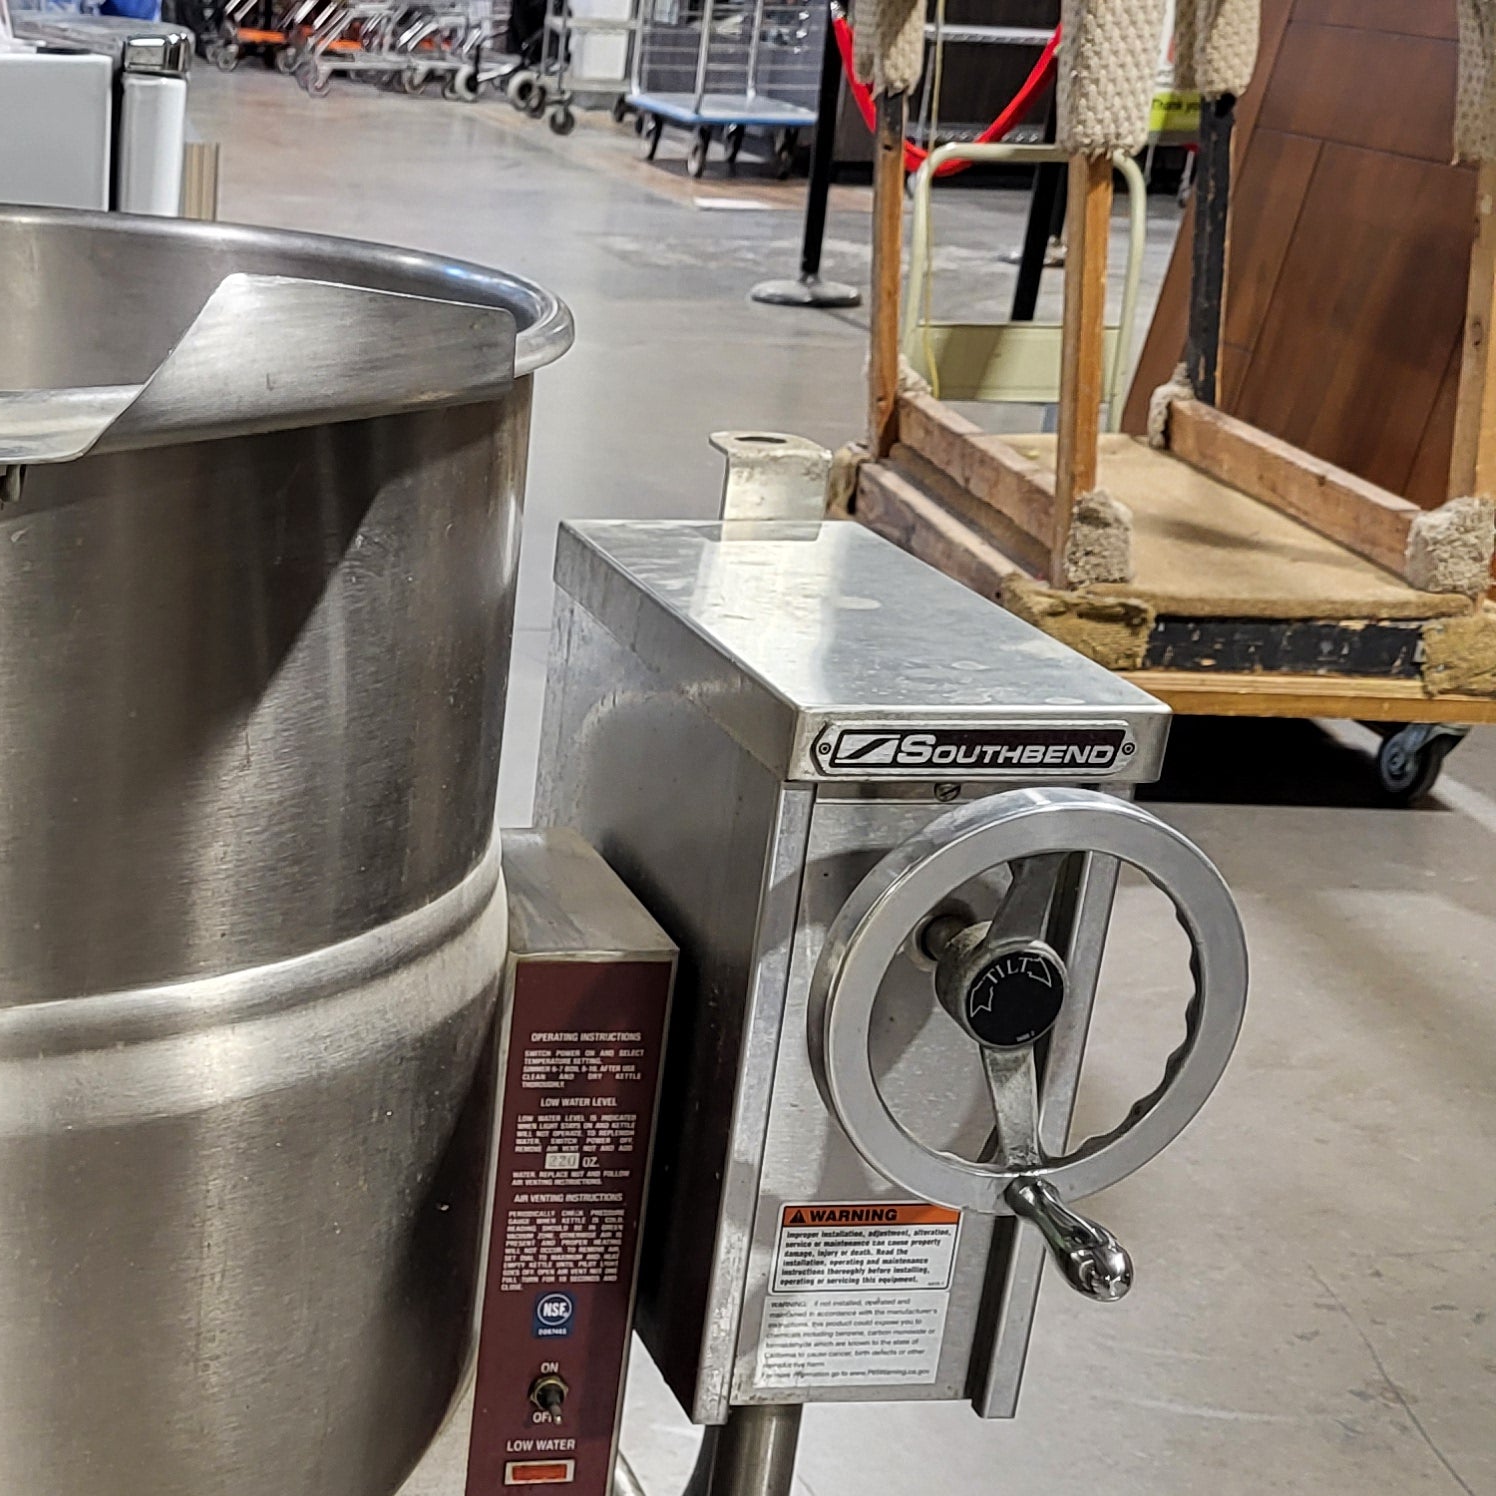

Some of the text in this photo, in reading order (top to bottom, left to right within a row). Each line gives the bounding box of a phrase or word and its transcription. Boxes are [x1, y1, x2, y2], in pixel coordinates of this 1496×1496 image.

[897, 734, 1116, 764] SOUTHBEND
[983, 957, 1033, 984] TILT
[531, 1032, 641, 1042] OPERATING INSTRUCTIONS
[540, 1096, 617, 1107] LOW WATER LEVEL
[582, 1157, 600, 1168] OZ.
[513, 1193, 623, 1203] AIR VENTING INSTRUCTIONS
[810, 1209, 897, 1222] WARNING
[787, 1228, 952, 1240] Improper installation, adjustment, alteration,
[824, 1239, 870, 1247] maintenance
[911, 1238, 941, 1247] property
[784, 1249, 815, 1258] damage,
[817, 1249, 838, 1258] injury
[850, 1248, 874, 1256] death.
[876, 1248, 894, 1256] Read
[783, 1258, 827, 1266] installation,
[830, 1258, 864, 1267] operating
[882, 1257, 928, 1265] maintenance
[781, 1266, 930, 1276] instructions thoroughly before installing,
[780, 1277, 815, 1287] operating
[827, 1276, 860, 1286] servicing
[862, 1275, 876, 1284] this
[878, 1275, 919, 1285] equipment.
[542, 1302, 569, 1318] NSF
[540, 1362, 559, 1374] ON
[532, 1411, 554, 1424] OF
[506, 1438, 576, 1452] LOW WATER
